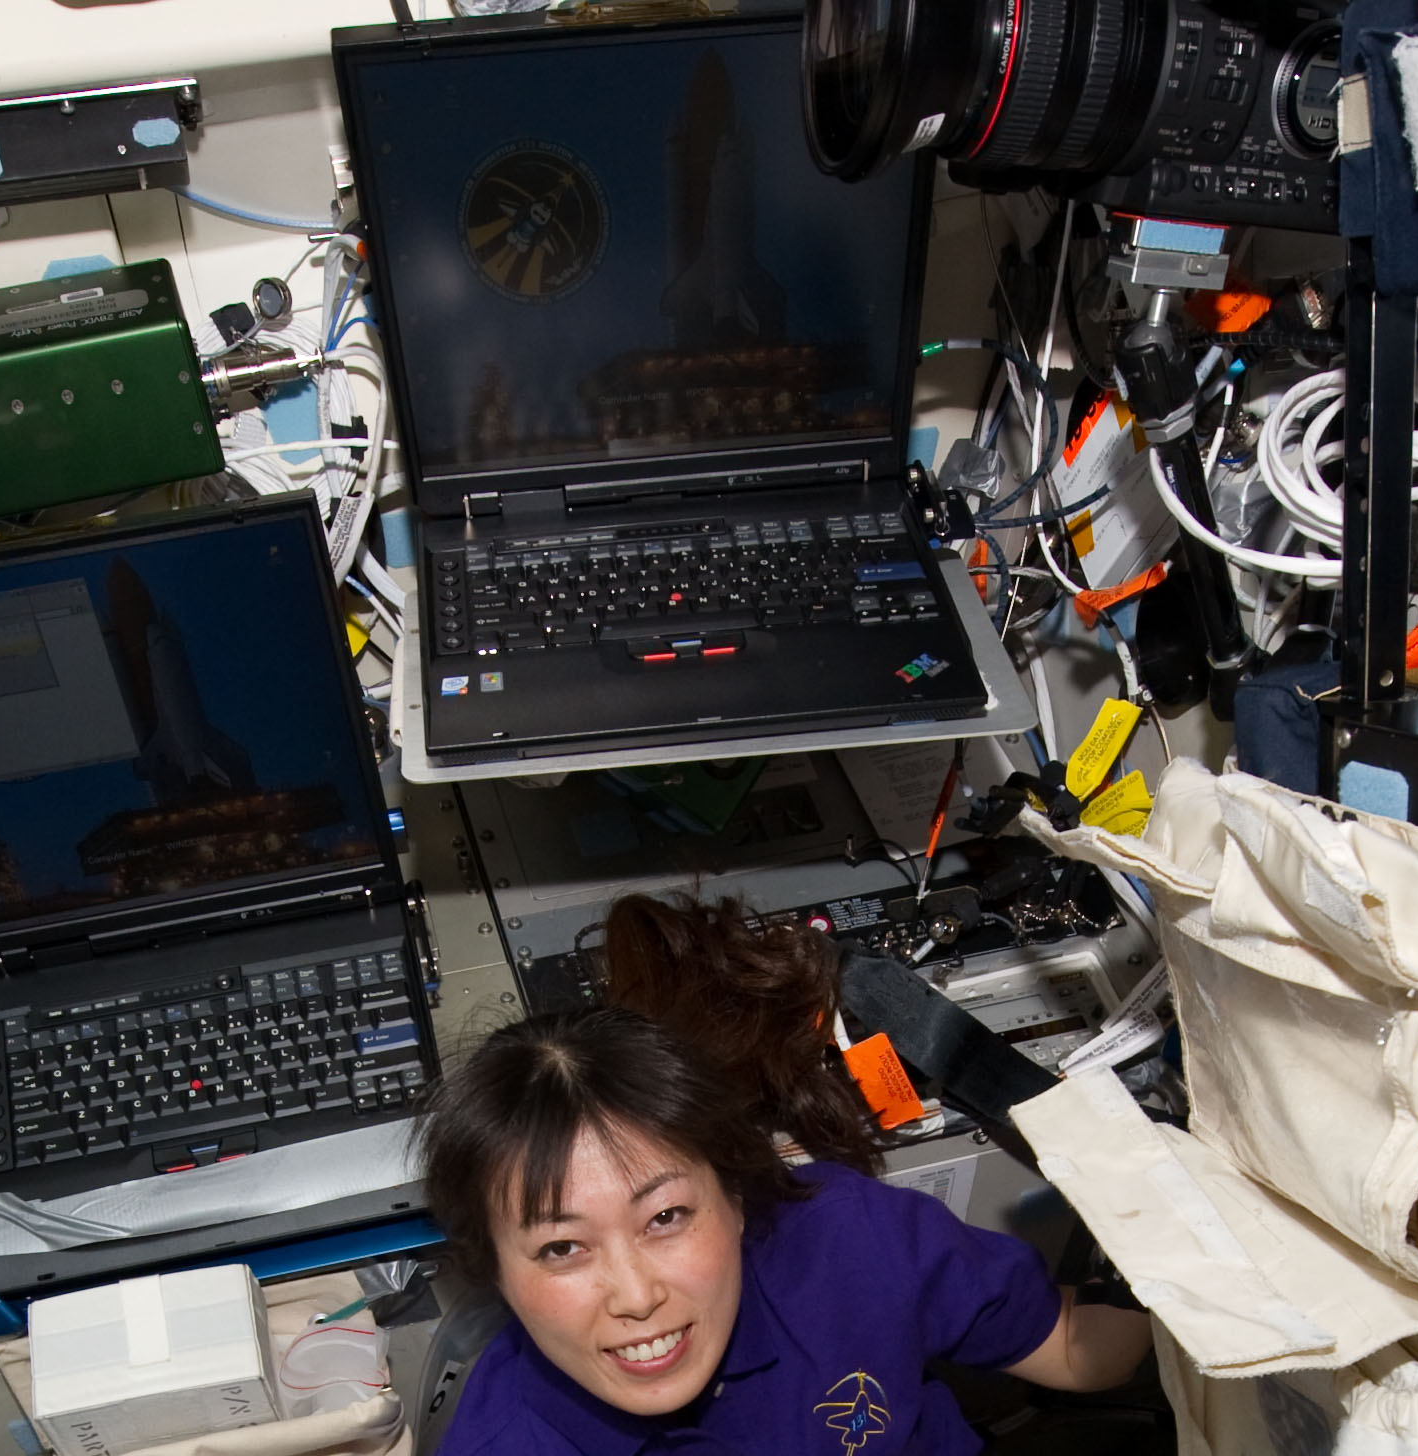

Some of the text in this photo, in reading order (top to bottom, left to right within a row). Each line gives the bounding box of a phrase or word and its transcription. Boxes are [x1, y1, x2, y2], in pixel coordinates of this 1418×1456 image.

[998, 12, 1014, 75] CANON HD
[46, 320, 76, 331] Power
[895, 652, 941, 682] IBM
[851, 1410, 867, 1431] 131
